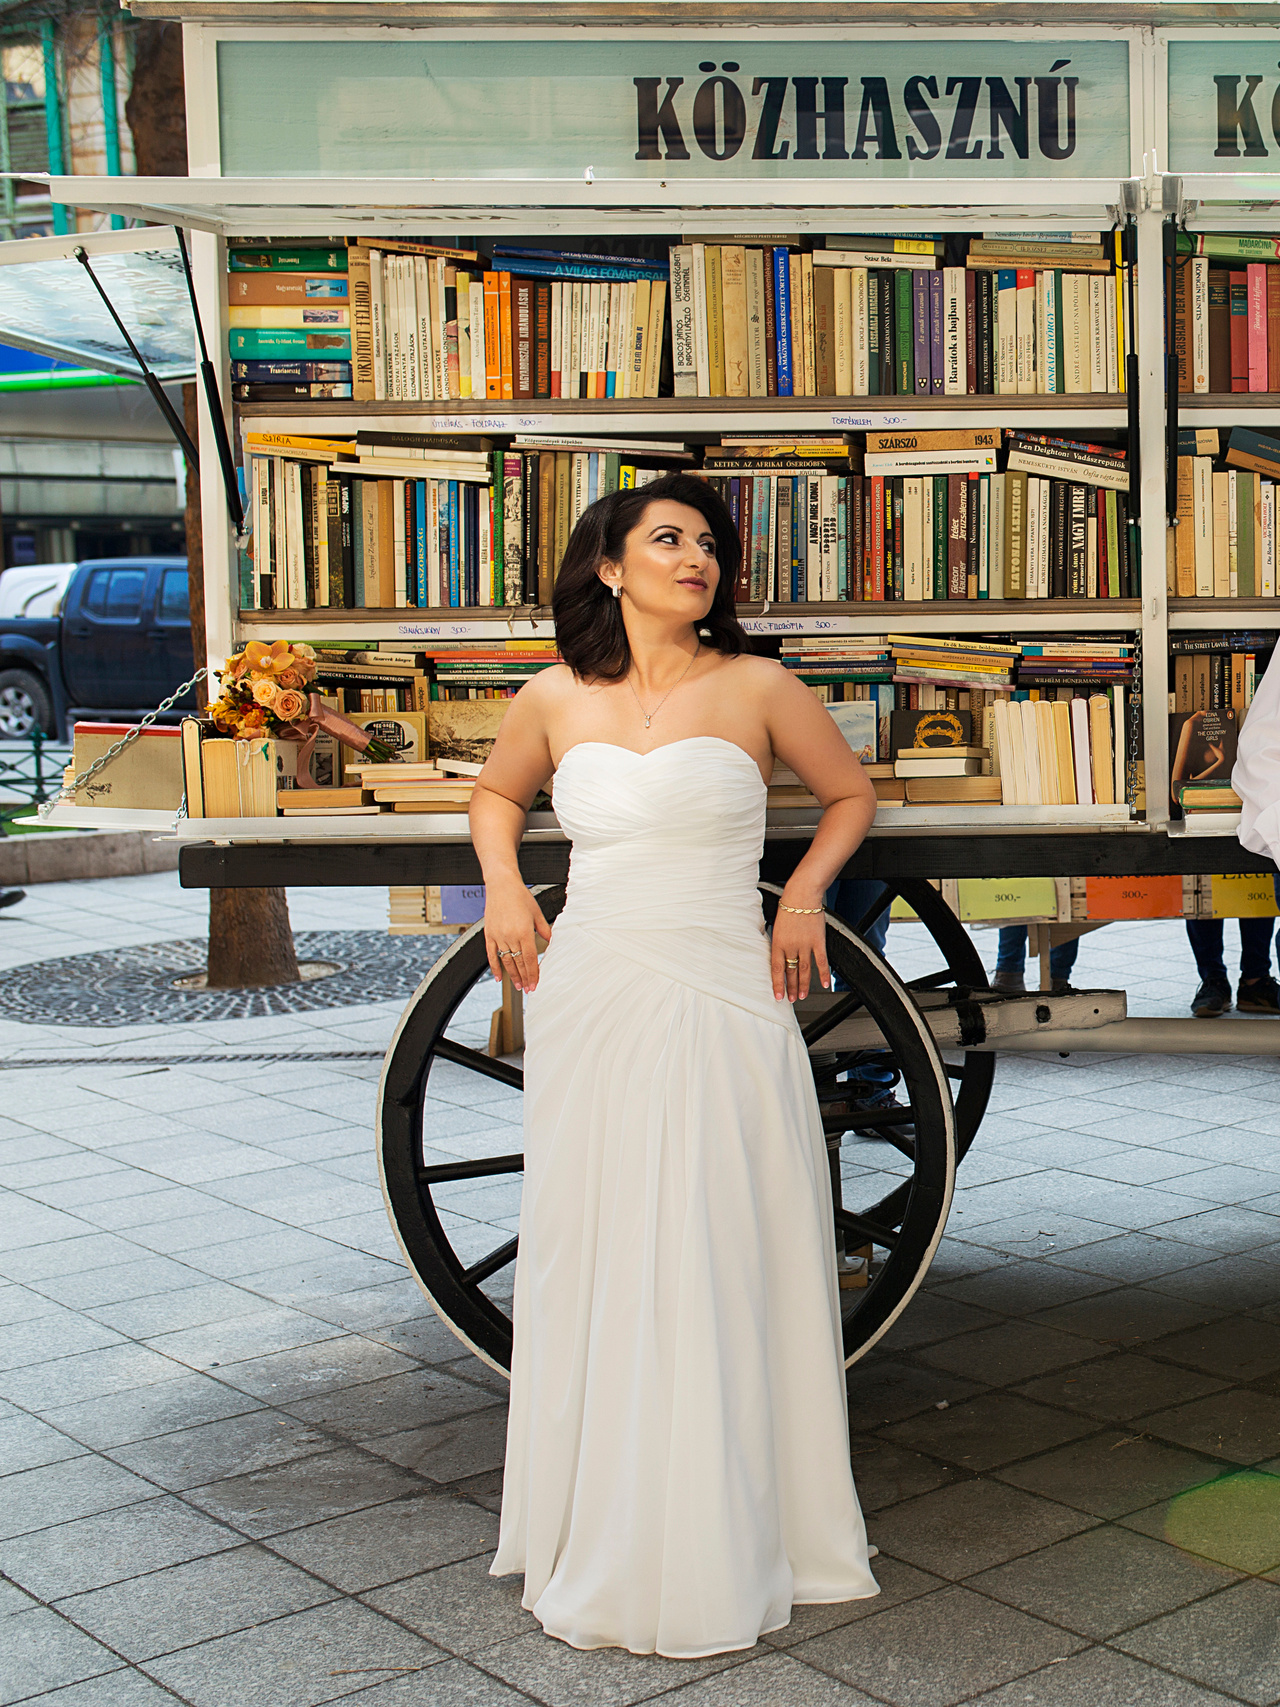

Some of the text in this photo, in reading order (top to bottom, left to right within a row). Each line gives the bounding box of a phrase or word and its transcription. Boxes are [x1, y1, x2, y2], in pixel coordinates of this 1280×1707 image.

[633, 60, 1079, 160] KÖZHASZNÚ
[673, 253, 682, 302] VENDÉGSÉGBEN
[682, 267, 691, 302] ŐSEINKNÉL
[764, 252, 774, 338] Bujdosó nyelvemlékeink
[779, 296, 787, 337] CSERKÉSZET
[948, 298, 960, 333] bajban
[1175, 297, 1186, 314] DER
[354, 281, 372, 384] FORDÍTOTT FÉLHOLD
[517, 287, 530, 391] MAGYARORSZÁGI KIRÁNDULÁSOK
[675, 319, 685, 367] BOROS JÁNOS
[682, 307, 693, 366] RAPCSÁNYI LÁSZLÓ
[1046, 311, 1056, 392] KONRÁD GYÖRGY
[1176, 318, 1187, 356] GRISHAM
[948, 343, 959, 383] Barátok
[1176, 357, 1187, 380] JOHN
[878, 435, 993, 449] SZÁRSZÓ 1943
[1019, 442, 1032, 451] Len
[341, 486, 350, 514] SOPRON
[959, 481, 968, 541] Jeruzsálemben
[1071, 487, 1086, 550] NAGY IMRE
[950, 518, 960, 540] Ítélet
[1011, 479, 1022, 590] KATONAI LEXIKON
[417, 527, 425, 600] OLASZORSZÁG
[780, 519, 789, 594] MÉRAY TIBOR
[950, 566, 960, 594] Gideon
[958, 561, 966, 594] Hausner
[1194, 642, 1210, 650] STREET
[462, 886, 485, 899] tec
[995, 893, 1021, 903] 300,-
[1122, 890, 1148, 900] 300,-
[1247, 892, 1274, 901] 300,-
